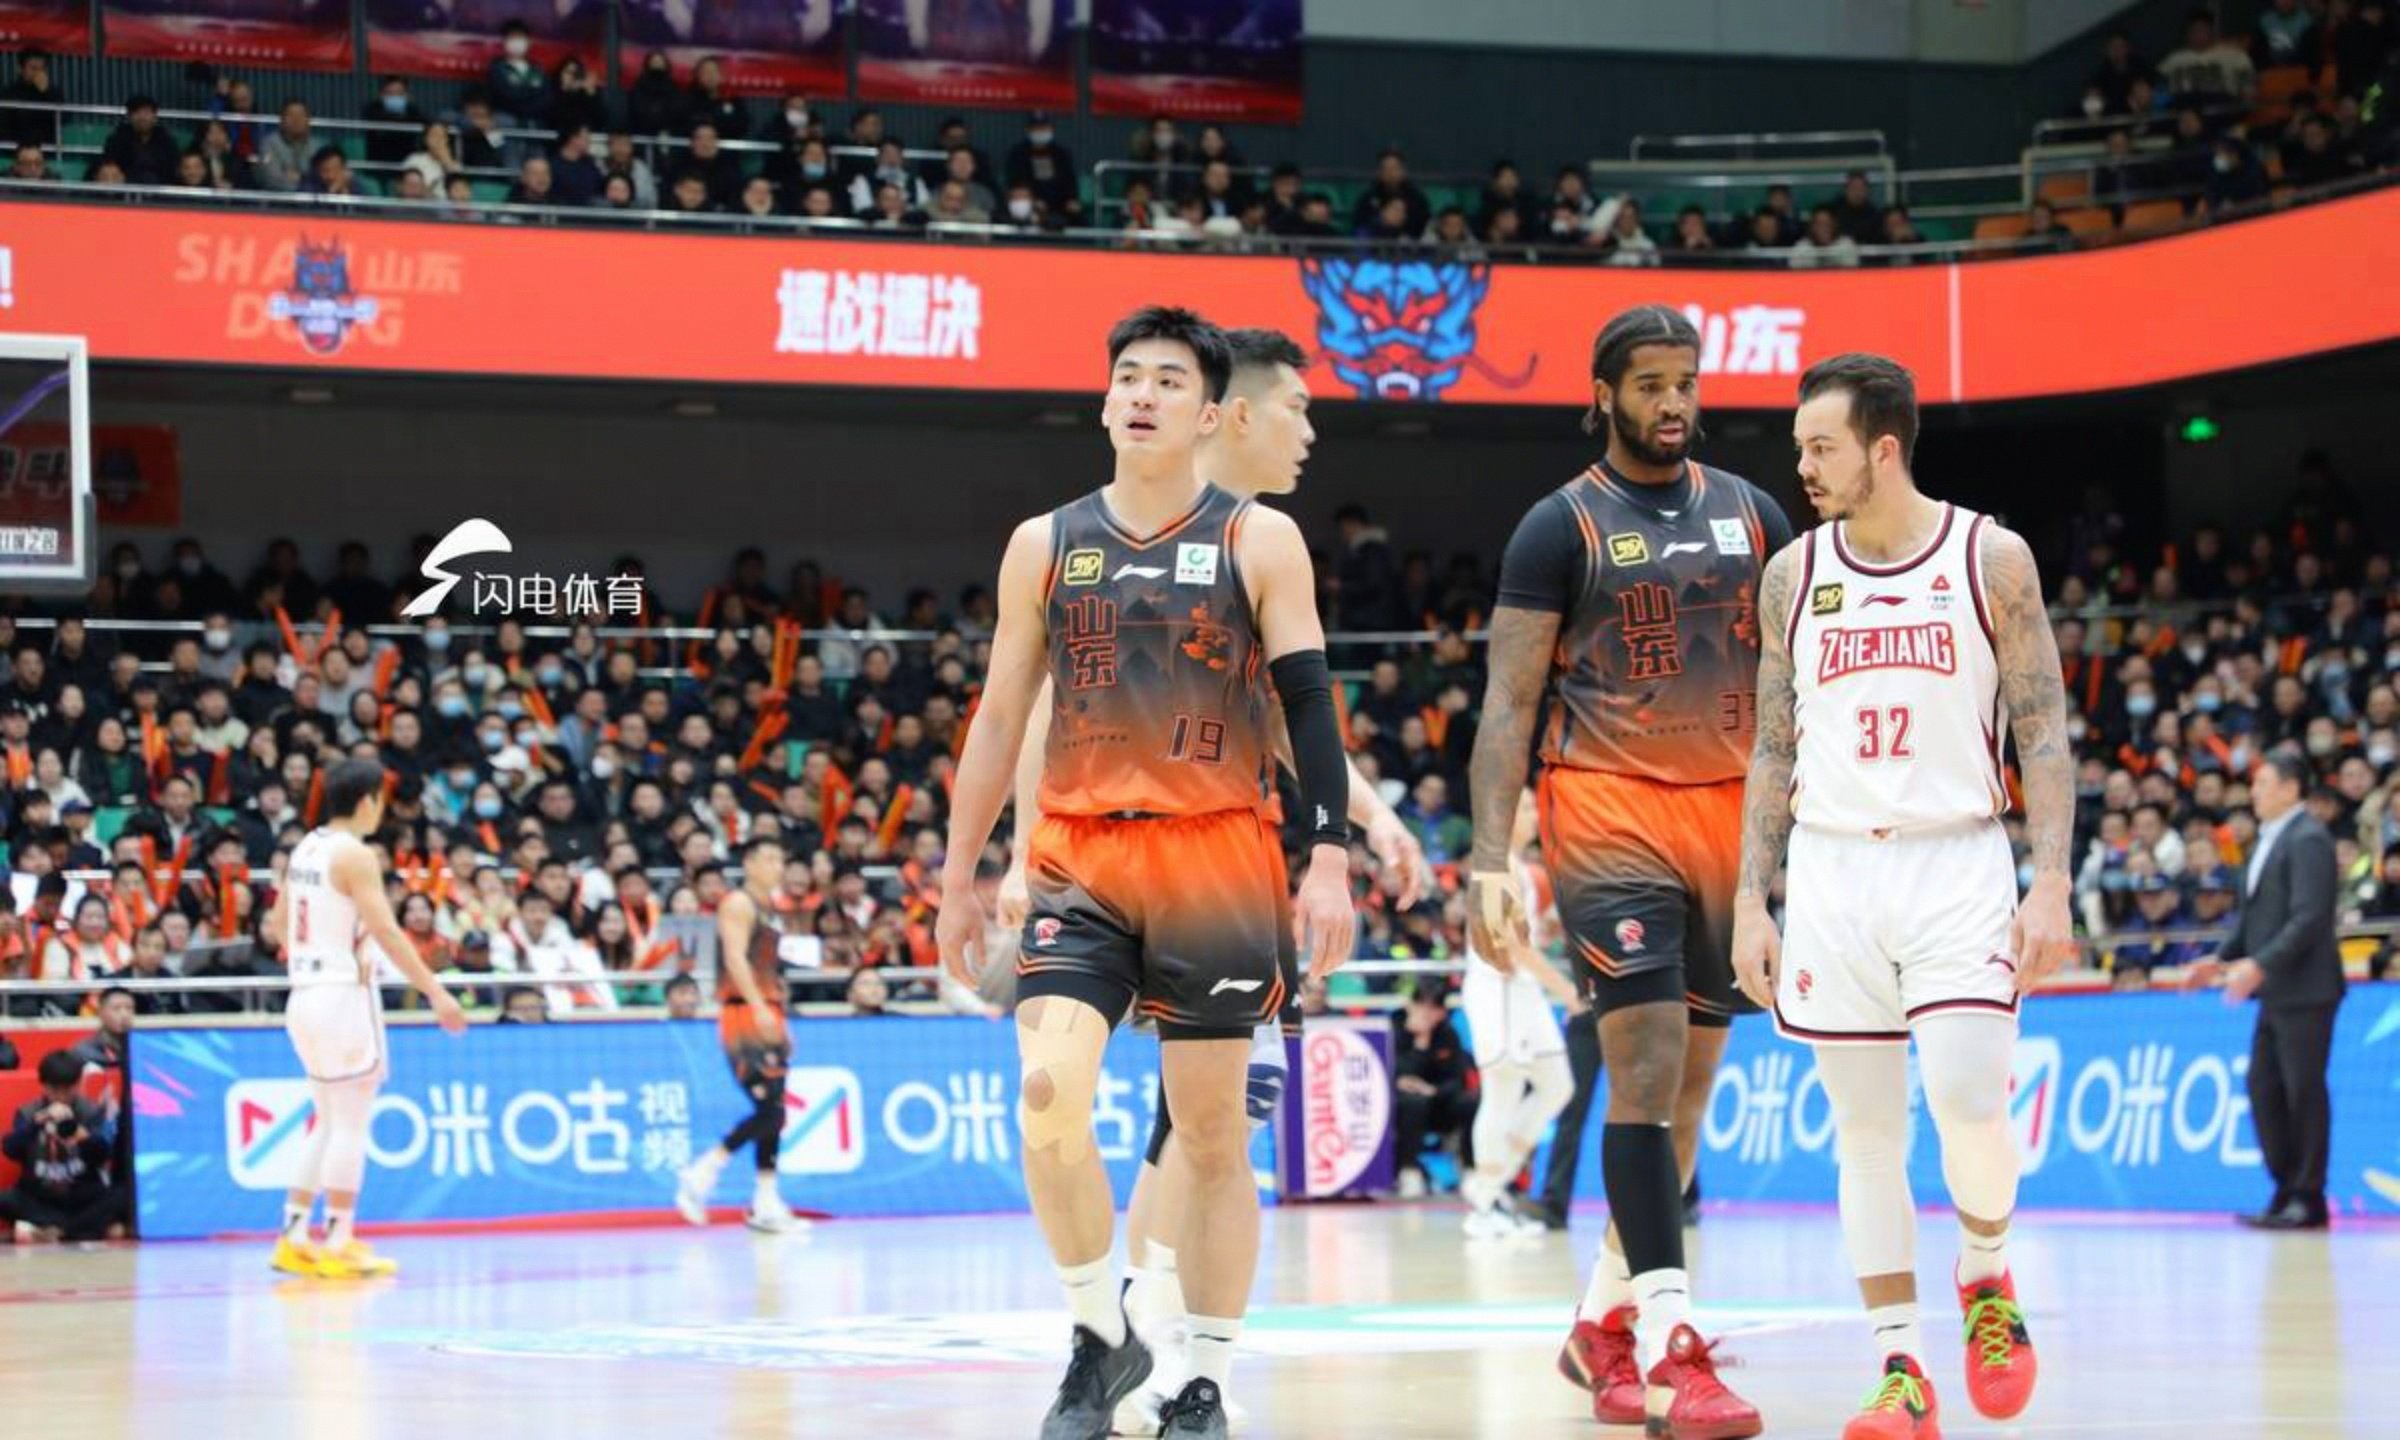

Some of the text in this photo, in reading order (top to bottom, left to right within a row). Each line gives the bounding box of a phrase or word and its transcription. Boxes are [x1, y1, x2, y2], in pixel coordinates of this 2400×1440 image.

[175, 234, 354, 287] SHA
[1065, 596, 1117, 691] 山东
[1620, 581, 1682, 680] 山东
[1819, 622, 1955, 685] ZHEJIANG
[1168, 714, 1226, 764] 19
[1857, 705, 1912, 761] 32
[639, 1081, 693, 1173] 视频
